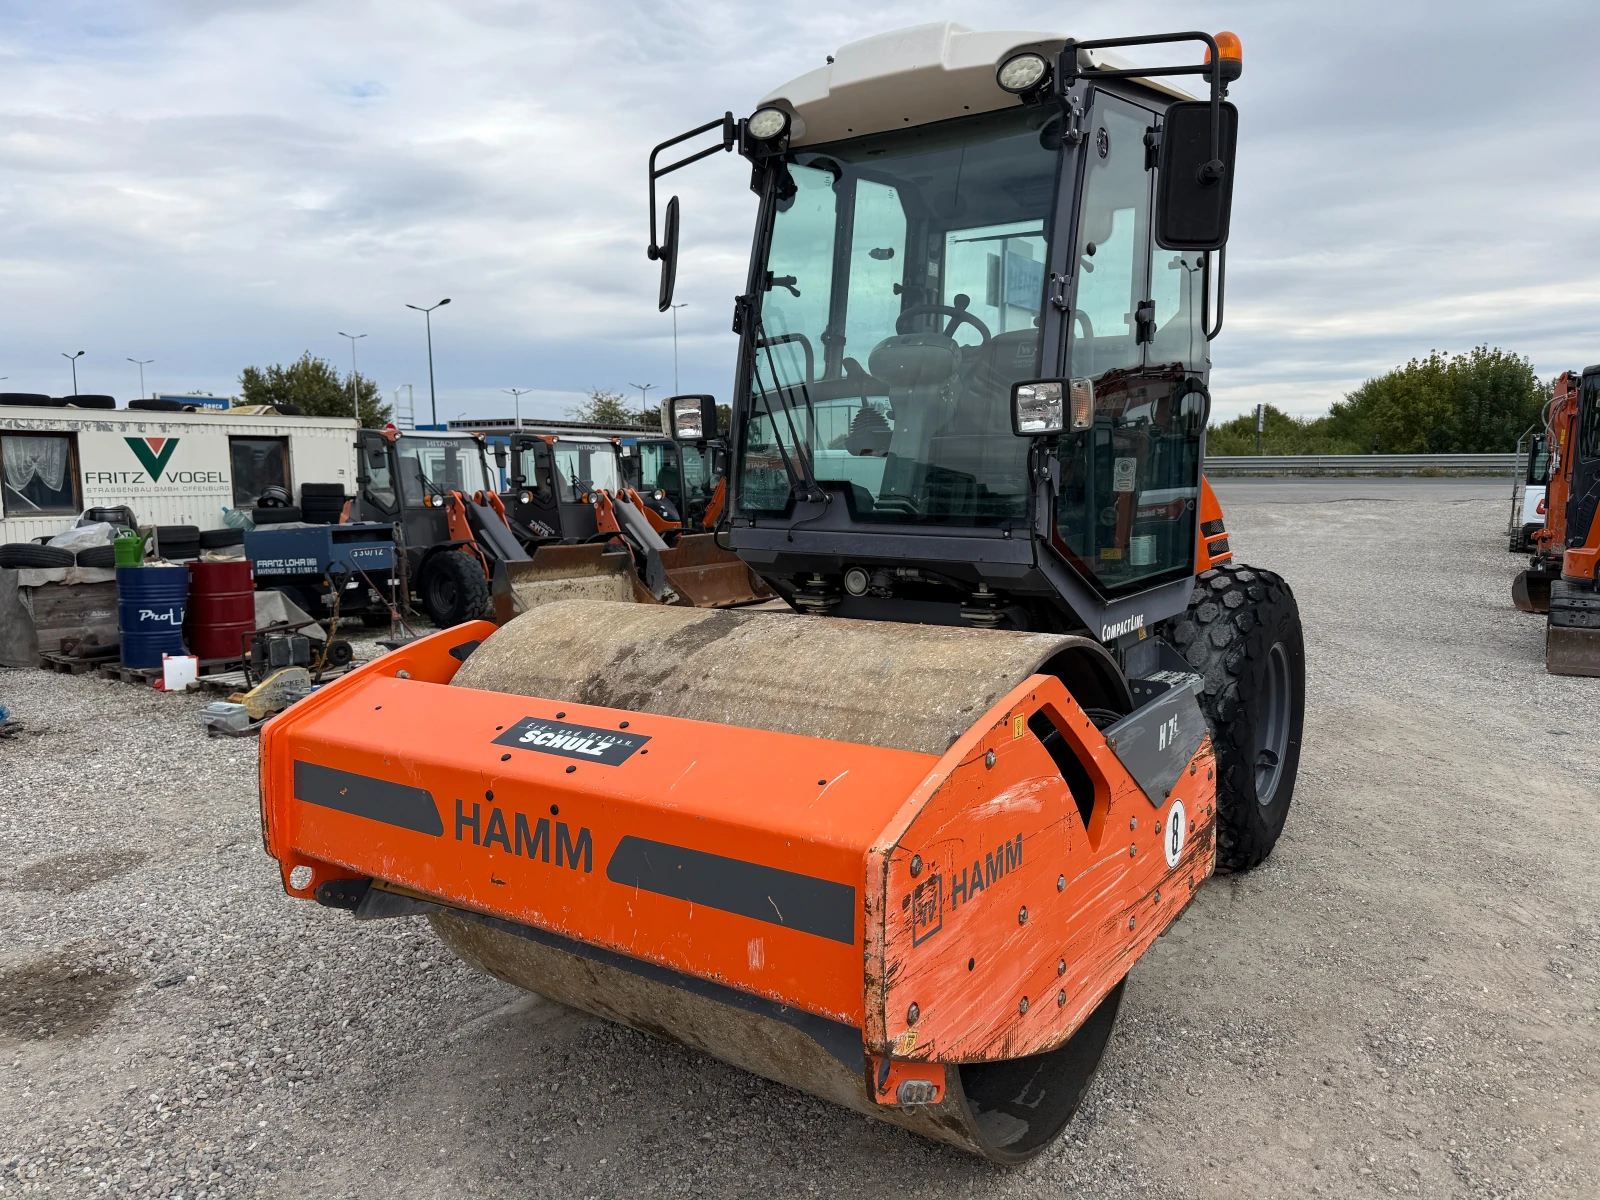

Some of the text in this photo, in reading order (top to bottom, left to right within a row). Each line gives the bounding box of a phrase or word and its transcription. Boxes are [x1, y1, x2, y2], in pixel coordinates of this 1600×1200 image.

[426, 440, 459, 448] HITACHI
[85, 471, 229, 484] FRITZ VOGEL
[256, 560, 284, 568] FRANZ
[284, 559, 306, 567] LOHR
[257, 567, 285, 575] RAVENSBURG
[272, 679, 305, 689] WACKER
[558, 728, 582, 737] und
[518, 730, 613, 756] SCHULZ
[455, 798, 593, 874] HAMM
[1171, 811, 1179, 856] 8
[952, 832, 1022, 911] HAMM
